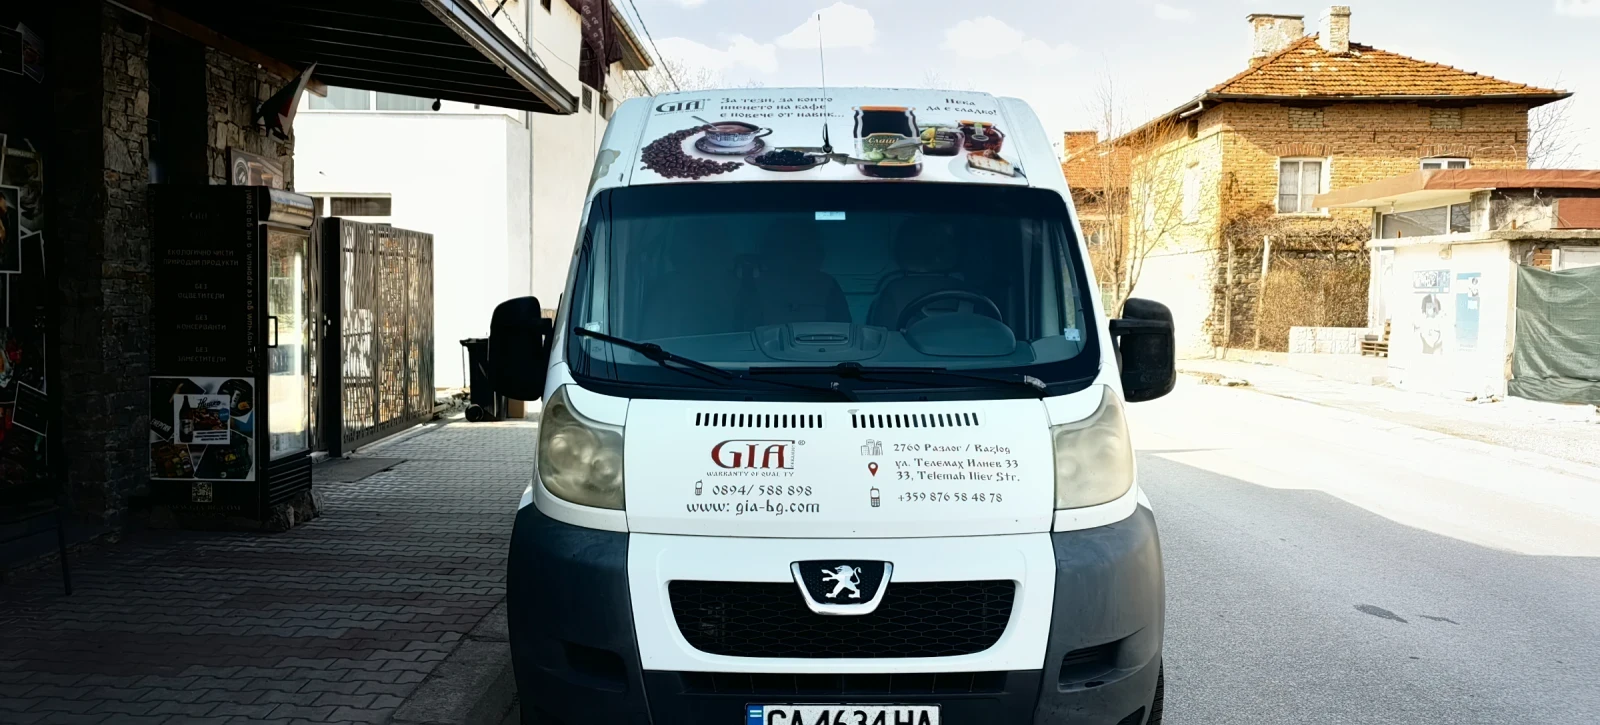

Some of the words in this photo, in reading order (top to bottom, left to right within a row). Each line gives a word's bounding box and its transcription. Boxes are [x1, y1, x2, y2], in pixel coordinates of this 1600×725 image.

[655, 98, 706, 113] GIA
[795, 103, 827, 112] кафе
[945, 98, 976, 106] Нека
[954, 106, 998, 116] сладко!
[202, 259, 239, 267] ПРОДУКТИ
[711, 439, 796, 469] GIA
[893, 443, 921, 452] 2760
[924, 443, 962, 453] Разлог
[975, 444, 1011, 455] Razlog
[895, 460, 911, 469] ул.
[914, 458, 965, 470] Телемах
[967, 458, 1002, 468] Илиев
[1005, 459, 1019, 469] 33
[896, 471, 914, 481] 33,
[917, 470, 966, 481] Telemah
[969, 471, 994, 481] Iliev
[996, 472, 1020, 482] Str.
[712, 484, 754, 496] 0894/
[758, 485, 783, 496] 588
[787, 485, 813, 497] 898
[897, 492, 927, 502] +359
[930, 492, 951, 502] 876
[954, 493, 968, 502] 58
[971, 493, 986, 502] 48
[989, 493, 1003, 503] 78
[686, 502, 730, 513] www:
[735, 499, 820, 516] gia-bg.com
